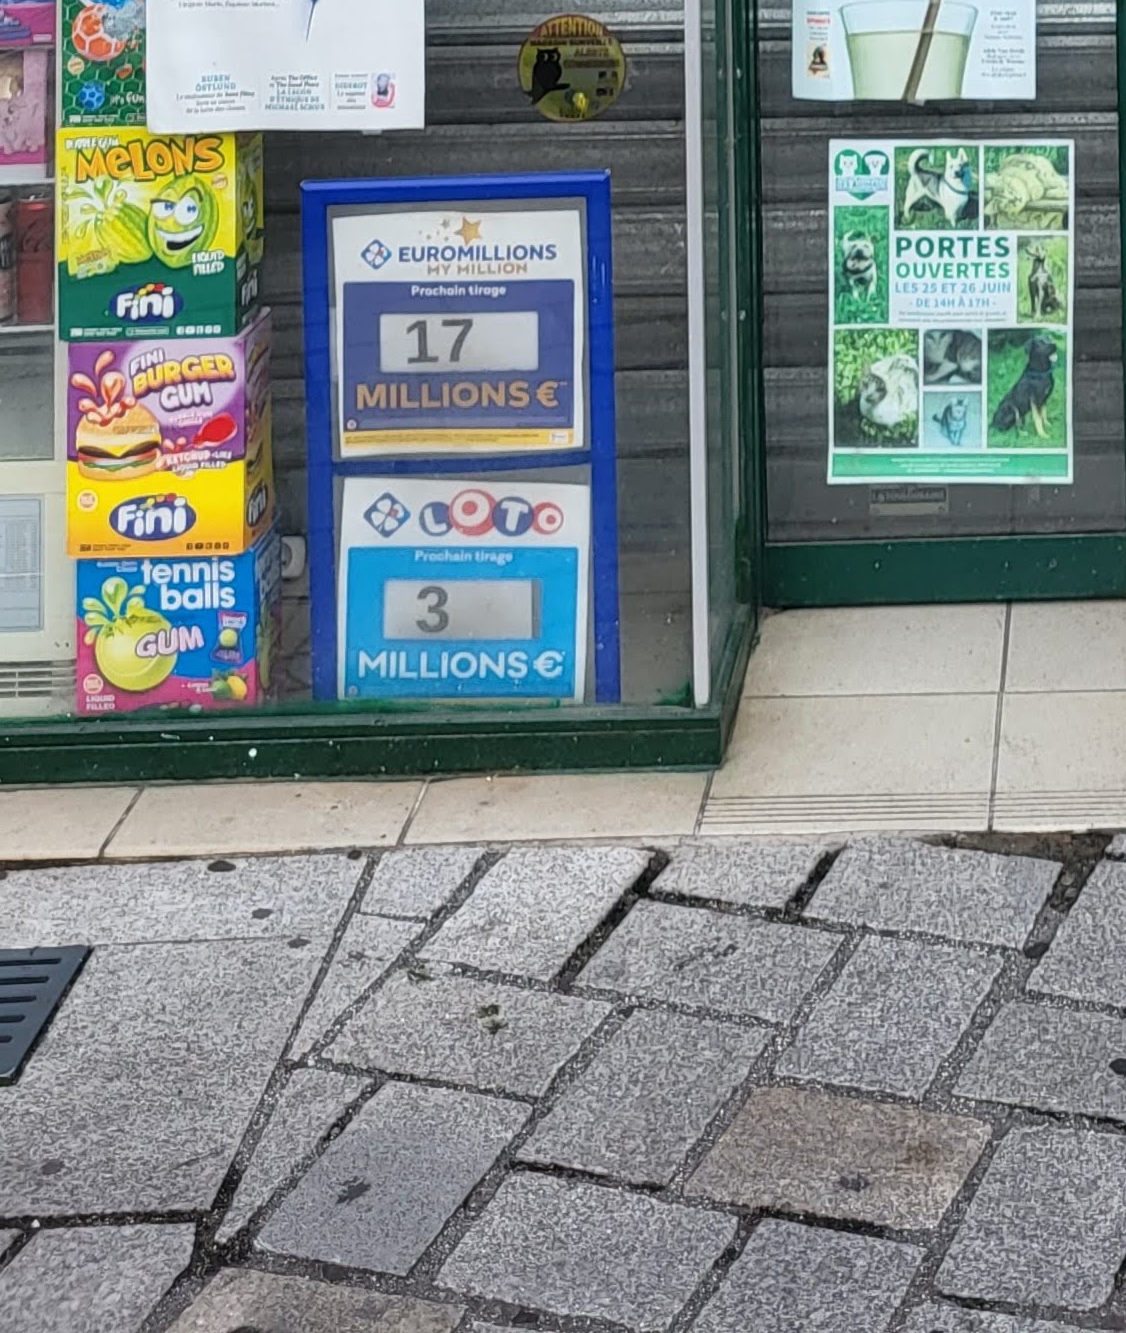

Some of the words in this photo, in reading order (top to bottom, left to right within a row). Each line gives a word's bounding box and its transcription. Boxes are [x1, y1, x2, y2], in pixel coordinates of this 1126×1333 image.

[398, 243, 557, 264] EUROMILLIONS
[895, 236, 1010, 259] PORTES
[895, 262, 1010, 279] OUVERTES
[116, 285, 175, 320] Fini
[411, 284, 466, 298] Prochain
[467, 284, 507, 300] tirage
[405, 317, 475, 366] 17
[132, 353, 237, 397] BURGER
[160, 381, 213, 412] GUM
[356, 380, 531, 411] MILLIONS
[419, 489, 564, 536] LOTO
[141, 556, 236, 584] tennis
[160, 582, 236, 611] balls
[416, 585, 451, 634] 3
[135, 625, 205, 658] GUM
[358, 650, 529, 680] MILLIONS
